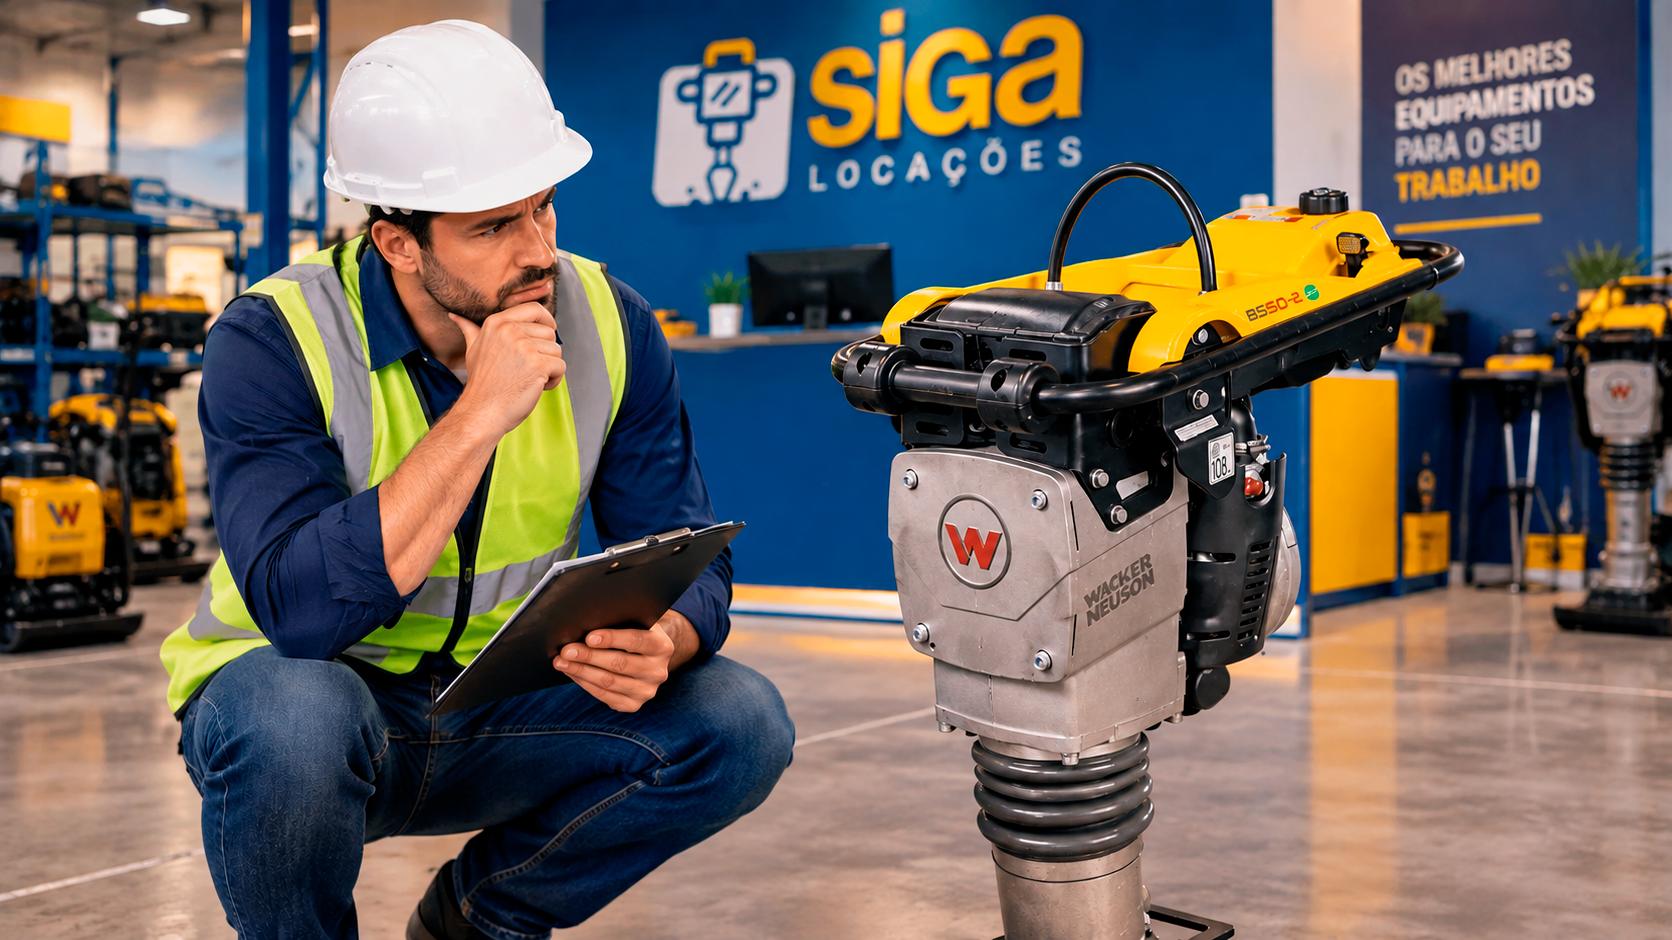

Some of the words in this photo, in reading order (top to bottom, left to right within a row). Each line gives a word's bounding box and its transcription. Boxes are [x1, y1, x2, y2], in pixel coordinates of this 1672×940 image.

[1395, 61, 1430, 95] OS
[1434, 38, 1572, 89] MELHORES
[1395, 73, 1595, 131] EQUIPAMENTOS
[809, 136, 1082, 192] LOCAÇÕES
[1395, 129, 1461, 167] PARA
[1465, 126, 1486, 159] O
[1490, 118, 1542, 156] SEU
[1394, 158, 1541, 203] TRABALHO
[47, 501, 81, 527] W
[945, 523, 1003, 571] W
[1083, 553, 1153, 609] WACKER
[1086, 568, 1155, 627] NEUSON
